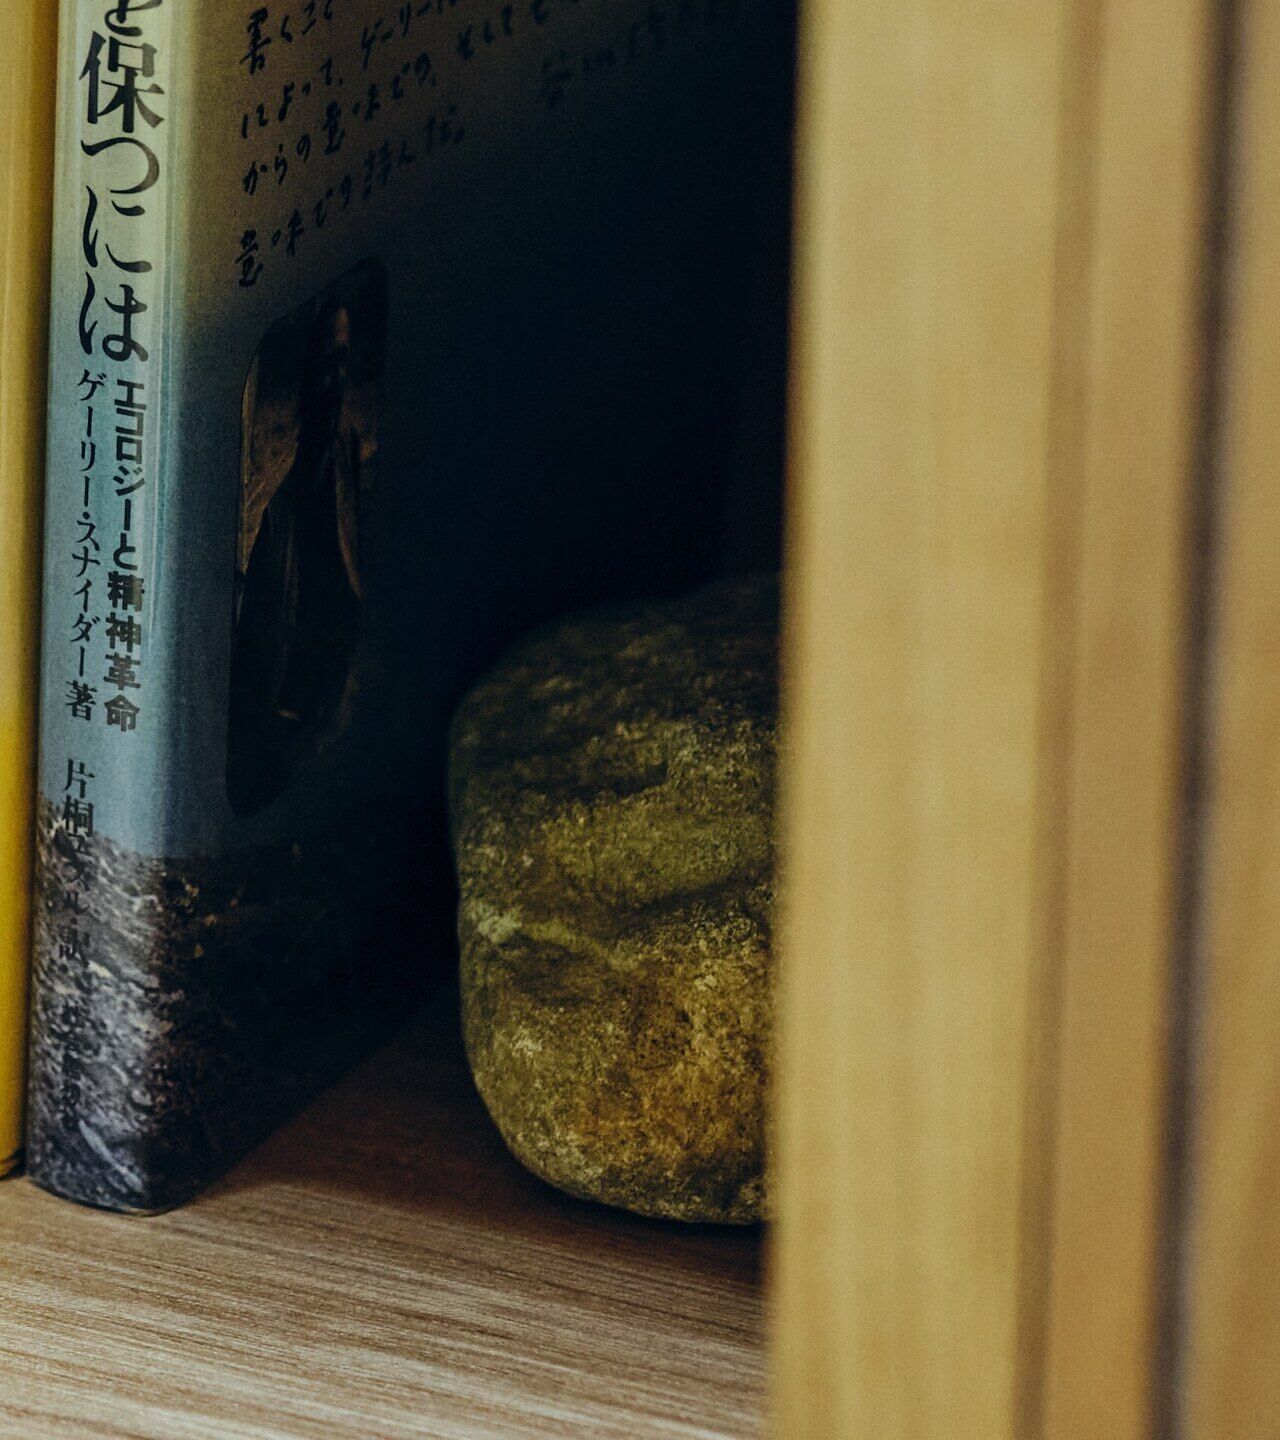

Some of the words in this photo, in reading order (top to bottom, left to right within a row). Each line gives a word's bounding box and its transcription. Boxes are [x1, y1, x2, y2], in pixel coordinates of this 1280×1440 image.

[65, 367, 107, 722] ゲーリー・スナイダー著
[103, 378, 147, 733] エコロジーと精神革命
